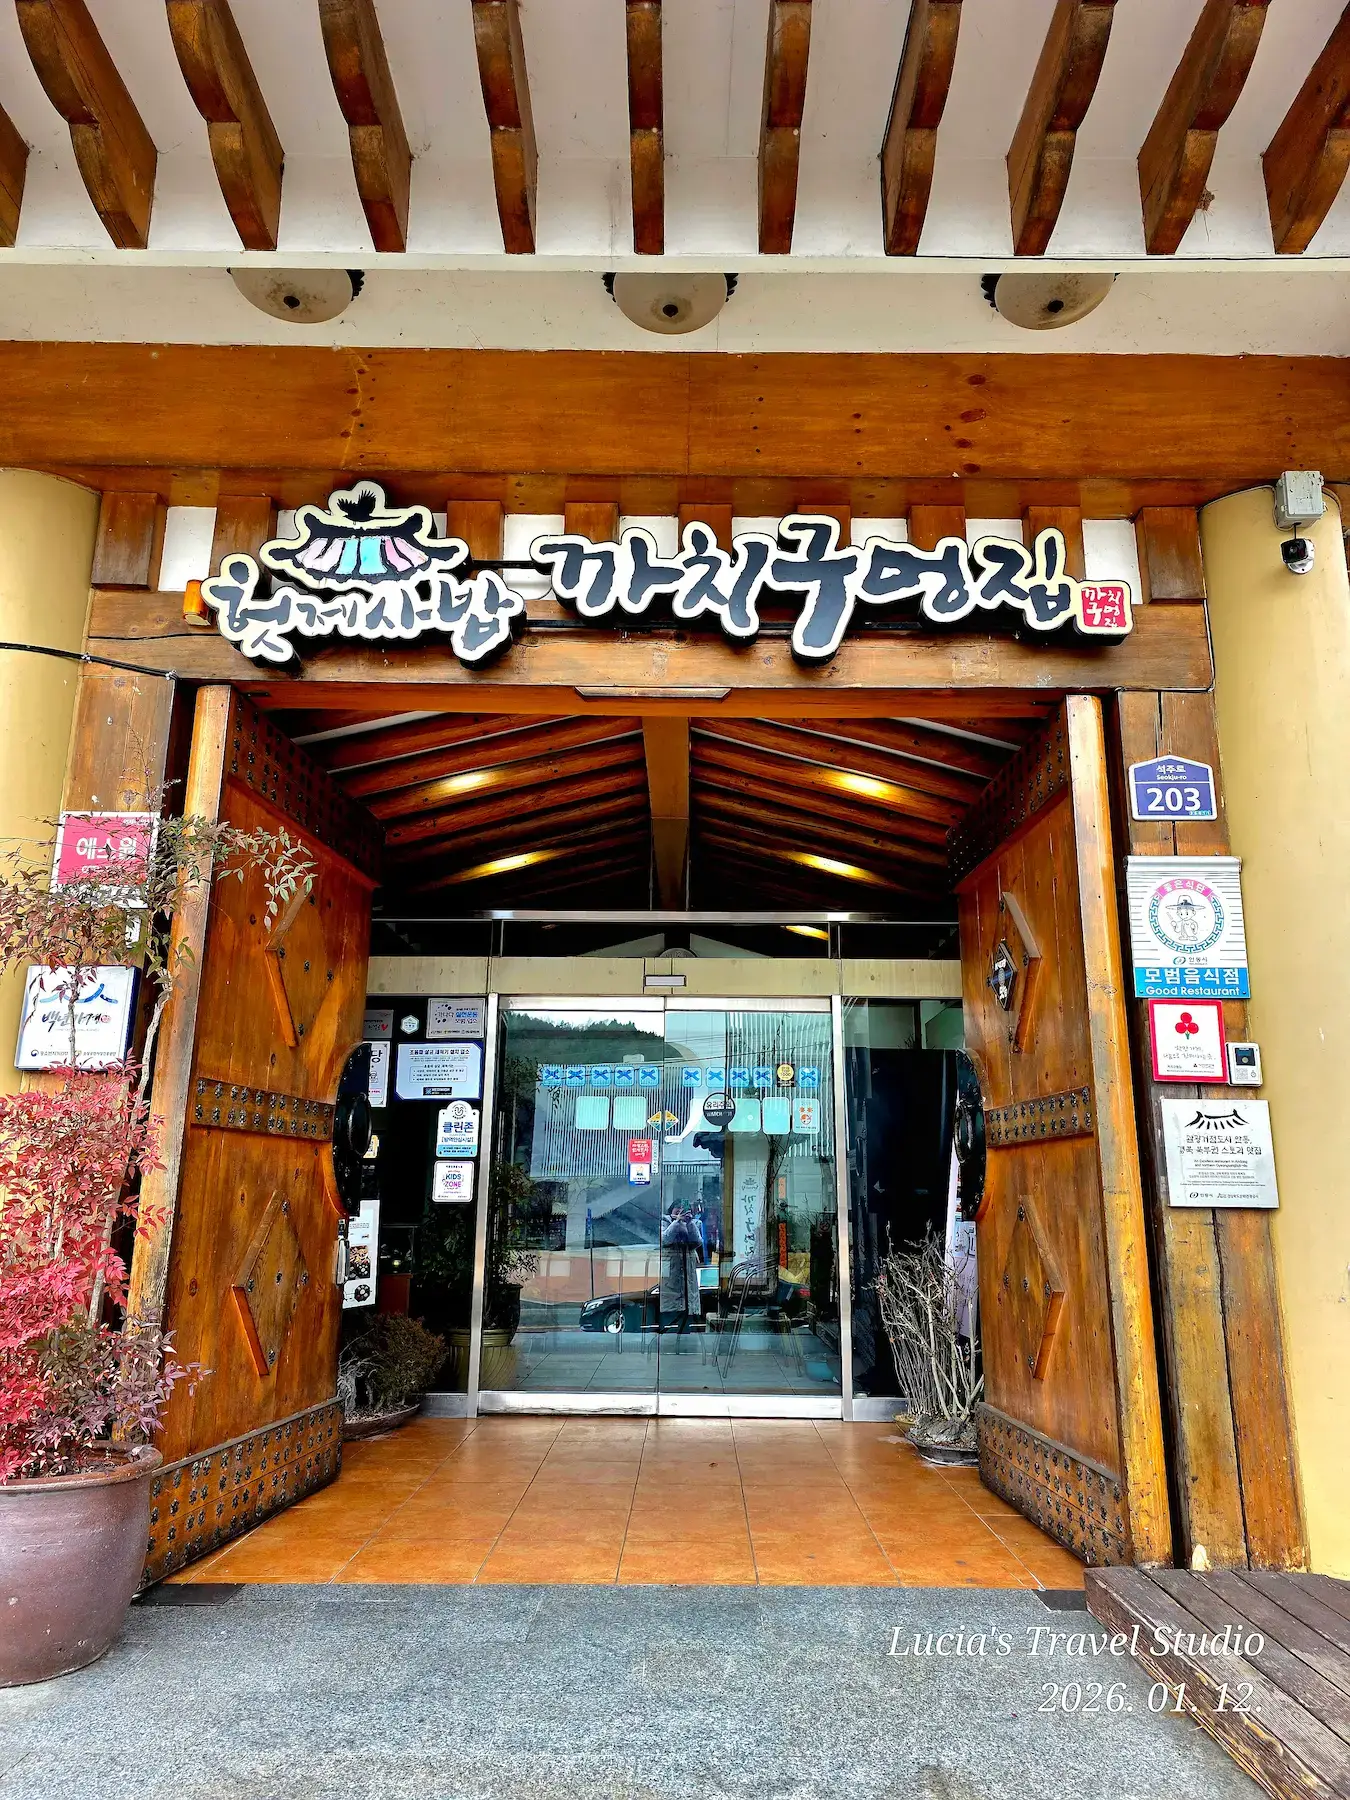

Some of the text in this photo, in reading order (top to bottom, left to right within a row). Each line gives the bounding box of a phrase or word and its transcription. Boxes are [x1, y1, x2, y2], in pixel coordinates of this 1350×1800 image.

[540, 521, 1071, 648] 까치구멍집
[1081, 586, 1121, 605] 까치
[1156, 764, 1186, 774] 석주로
[1146, 787, 1201, 812] 203
[1144, 968, 1240, 985] 모범음식점
[1146, 986, 1240, 996] Good Restaurant
[442, 1121, 474, 1133] 클린존
[1221, 1146, 1244, 1155] 스토리
[1246, 1146, 1262, 1155] 맛집
